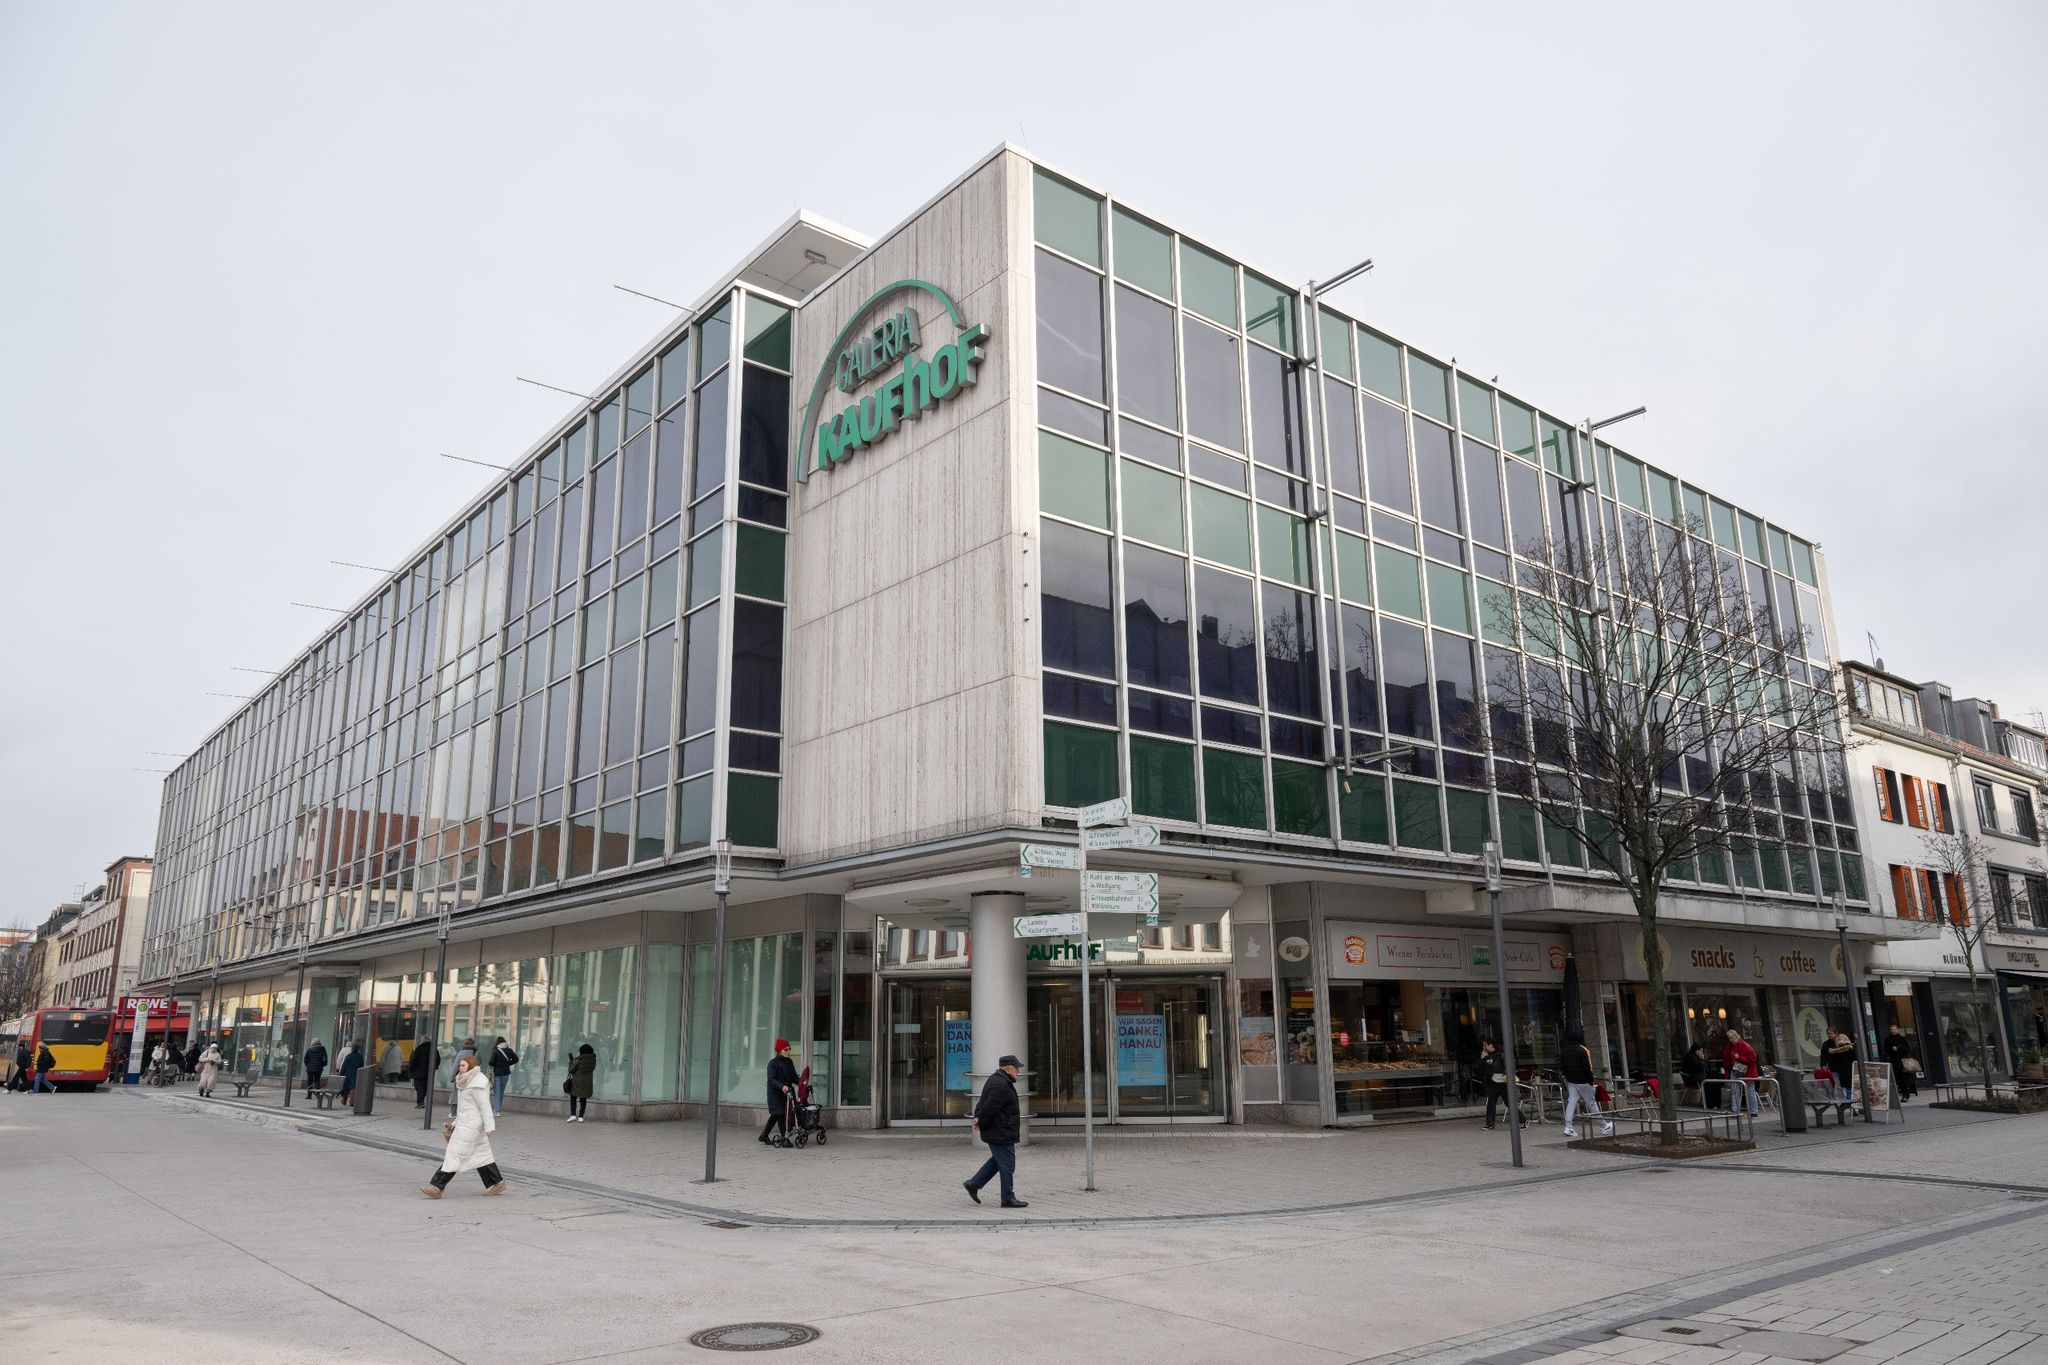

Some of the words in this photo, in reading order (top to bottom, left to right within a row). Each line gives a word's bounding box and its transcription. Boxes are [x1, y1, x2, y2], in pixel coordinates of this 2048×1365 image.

[835, 306, 922, 394] GALERIA
[1096, 882, 1122, 890] Wolfgang
[1690, 944, 1736, 970] snacks
[1780, 949, 1817, 974] coffee
[1118, 1018, 1134, 1026] WIR
[1136, 1018, 1162, 1026] SAGEN
[1118, 1026, 1162, 1037] DANKE,
[1120, 1038, 1162, 1049] HANAU
